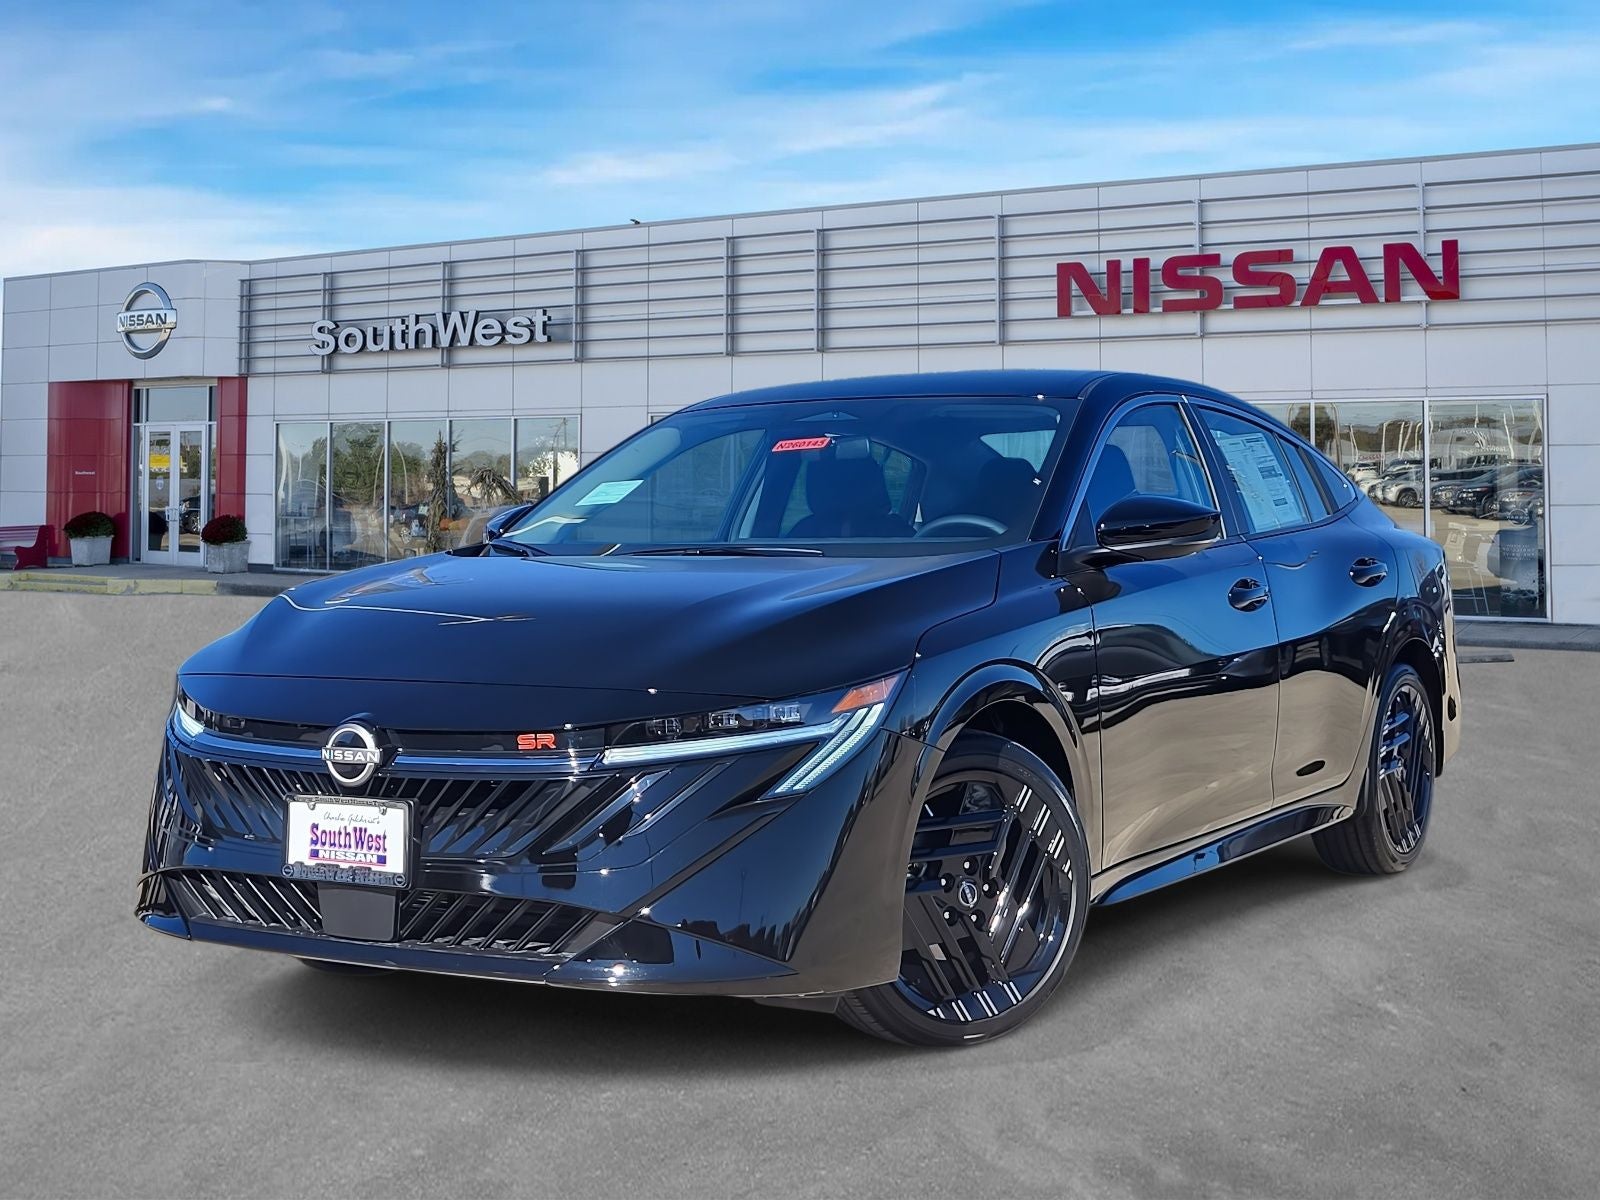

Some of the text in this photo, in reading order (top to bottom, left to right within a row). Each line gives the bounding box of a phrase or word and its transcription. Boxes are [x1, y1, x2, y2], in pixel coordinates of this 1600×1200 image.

[1056, 239, 1461, 318] NISSAN
[119, 312, 168, 328] NISSAN
[309, 308, 552, 356] SouthWest
[517, 733, 557, 750] SR
[321, 748, 378, 762] NISSAN
[318, 848, 378, 863] NISSAN
